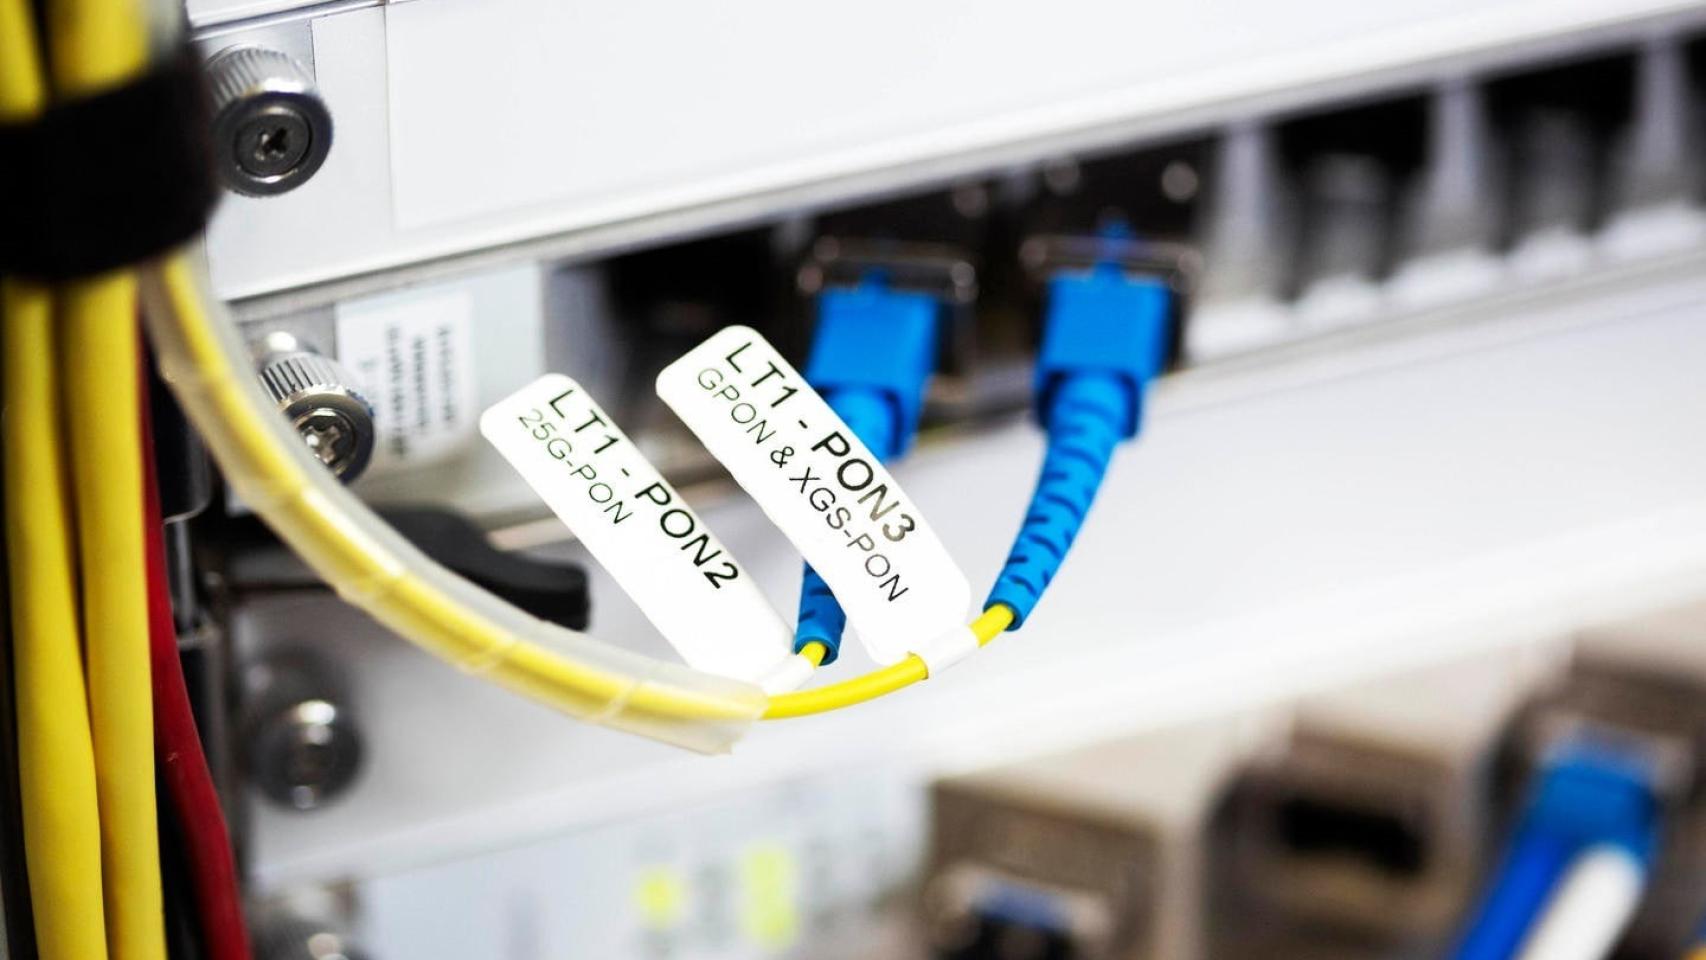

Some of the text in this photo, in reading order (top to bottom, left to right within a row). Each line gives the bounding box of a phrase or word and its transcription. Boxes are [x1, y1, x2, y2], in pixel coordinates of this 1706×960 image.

[518, 409, 633, 525] 25G-PON
[548, 390, 620, 455] LT1
[635, 482, 739, 589] PON2
[697, 367, 909, 603] GPON & XGS-PON
[725, 341, 798, 409] LT1
[811, 430, 916, 544] PON3
